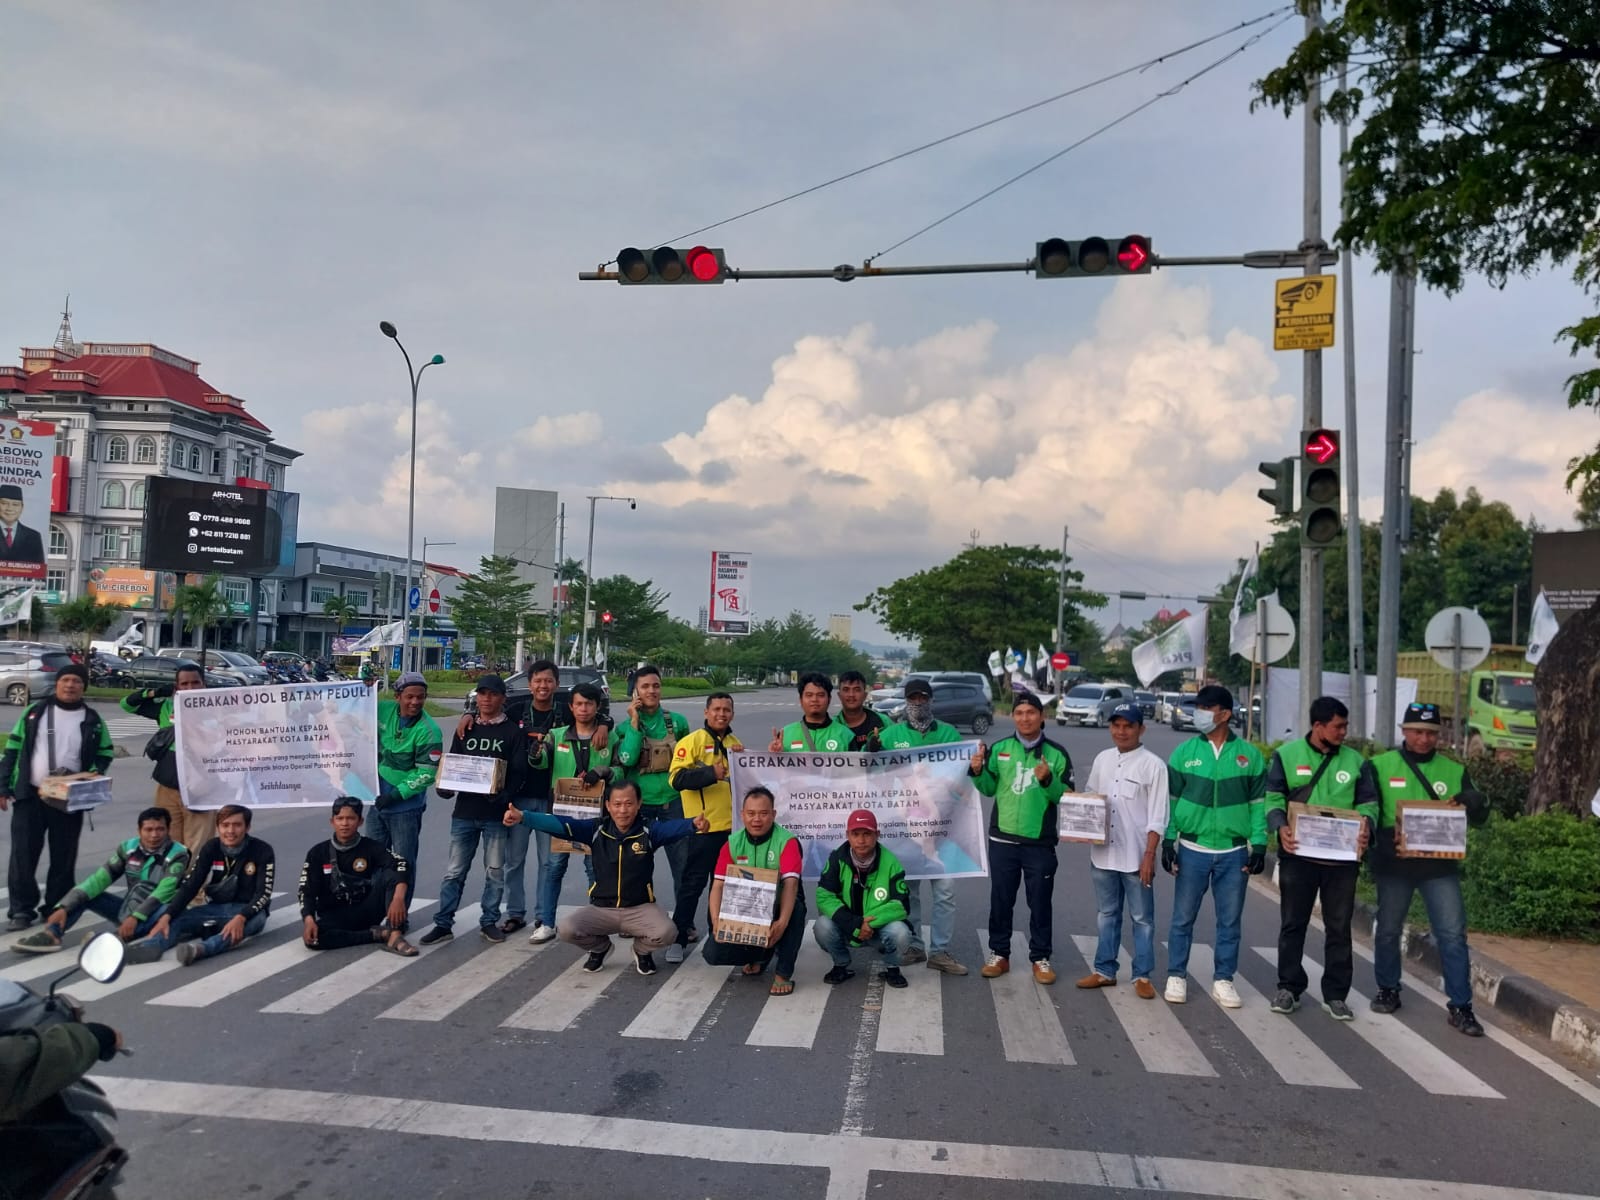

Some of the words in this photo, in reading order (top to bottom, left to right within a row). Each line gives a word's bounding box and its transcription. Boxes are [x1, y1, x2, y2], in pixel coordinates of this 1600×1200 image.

[111, 584, 148, 592] CIREBON
[183, 694, 239, 709] GERAKAN
[243, 692, 277, 705] OJOL
[280, 690, 323, 703] BATAM
[327, 686, 370, 700] PEDULI
[226, 728, 257, 736] MOHON
[259, 726, 296, 735] BANTUAN
[299, 724, 329, 733] KEPADA
[226, 736, 277, 746] MASYARAKAT
[280, 735, 301, 743] KOTA
[303, 733, 330, 742] BATAM
[466, 737, 505, 752] ODK
[738, 756, 807, 768] GERAKAN
[812, 756, 854, 768] OJOL
[859, 753, 912, 768] BATAM
[918, 748, 971, 763] PEDULI
[790, 791, 828, 800] MOHON
[832, 791, 877, 800] BANTUAN
[881, 789, 919, 798] KEPADA
[789, 801, 853, 811] MASYARAKAT
[857, 800, 883, 809] KOTA
[887, 799, 920, 808] BATAM
[827, 821, 846, 829] kami
[909, 819, 952, 827] kecelakaan
[923, 829, 948, 838] Tulang
